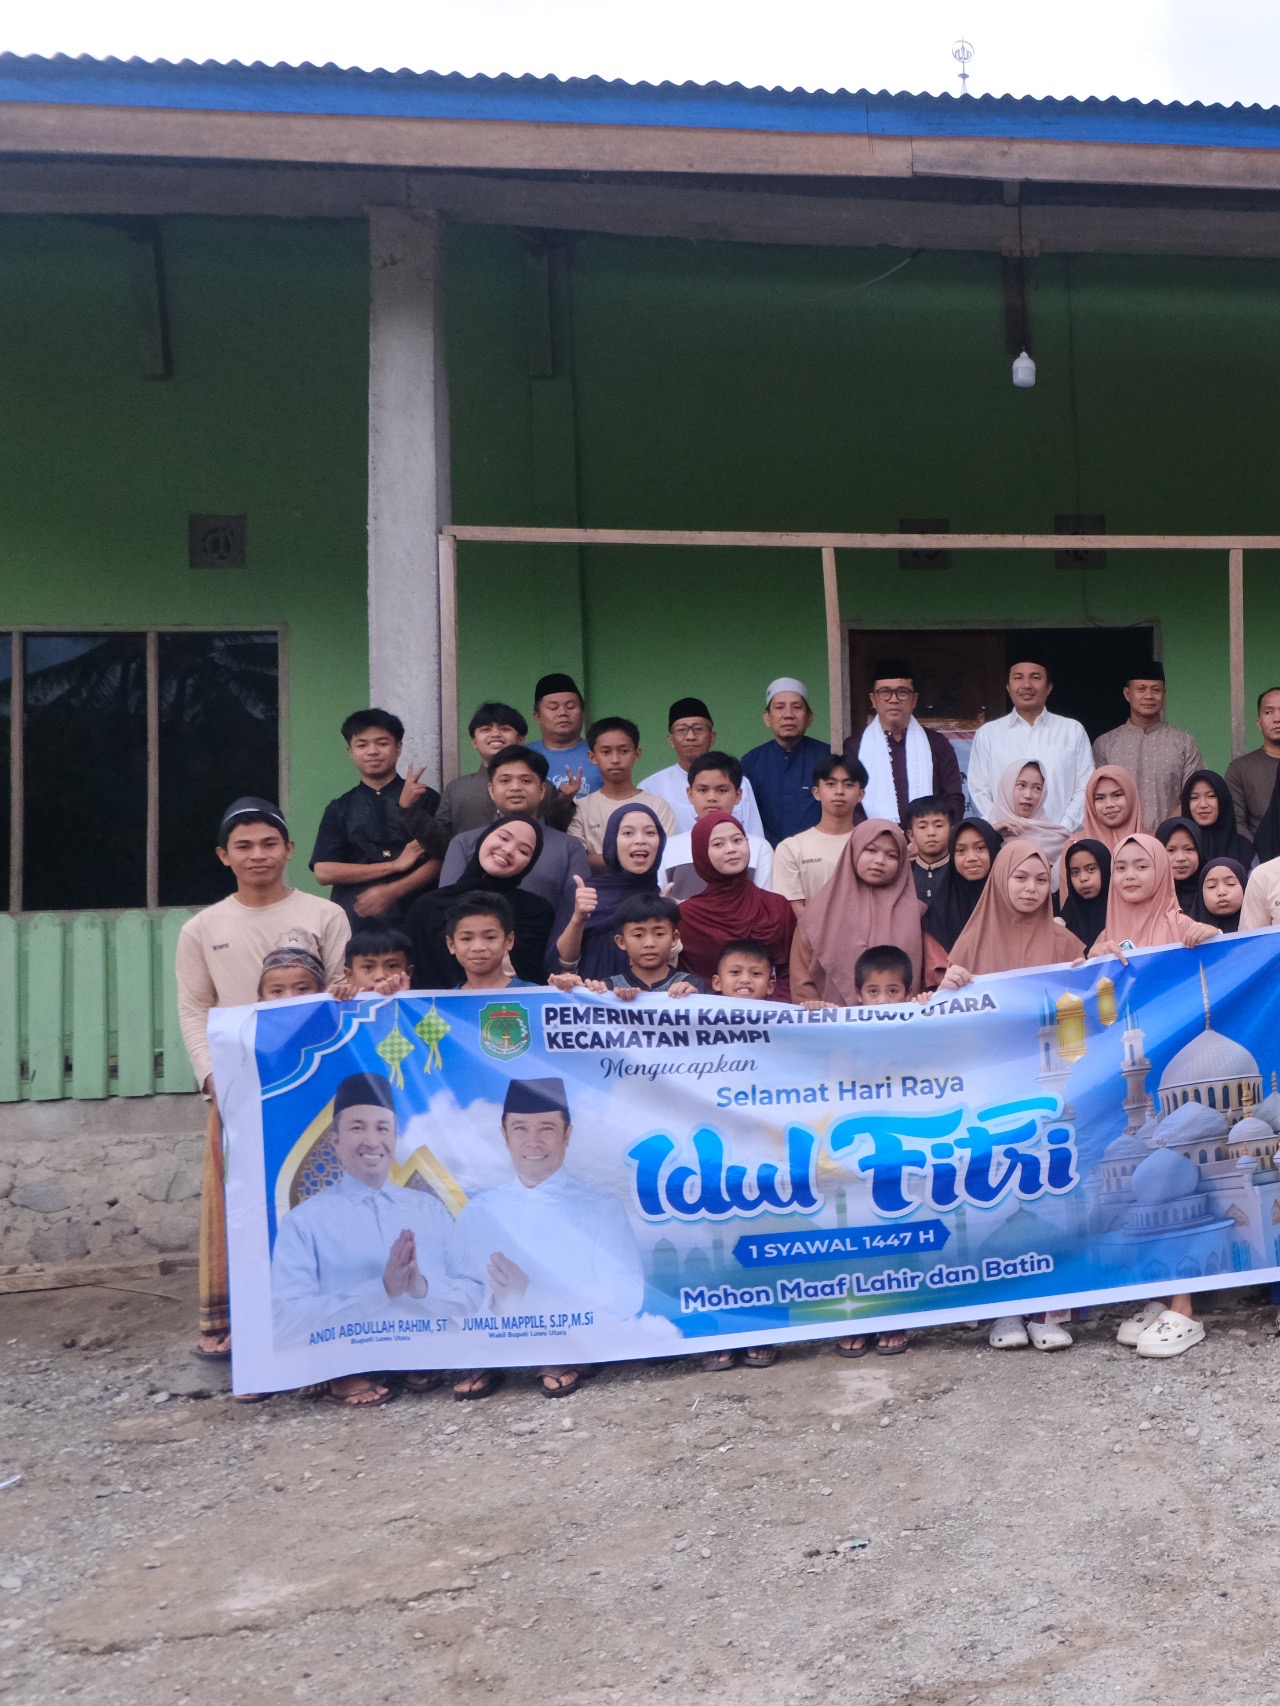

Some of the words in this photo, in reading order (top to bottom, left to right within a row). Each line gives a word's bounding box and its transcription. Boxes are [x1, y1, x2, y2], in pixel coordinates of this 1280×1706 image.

[545, 1006, 691, 1026] PEMERINTAH
[698, 1008, 837, 1026] KABUPATEN
[547, 1030, 690, 1049] KECAMATAN
[696, 1029, 770, 1046] RAMPI
[600, 1053, 758, 1081] Mengucapkan
[716, 1084, 829, 1108] Selamat
[838, 1075, 891, 1101] Hari
[901, 1075, 964, 1099] Raya
[627, 1126, 816, 1216] Idul
[829, 1097, 1077, 1213] Fitri
[749, 1245, 758, 1259] 1
[764, 1237, 858, 1258] SYAWAL
[862, 1232, 913, 1249] 1447
[919, 1229, 935, 1244] H
[684, 1287, 771, 1310] Mohon
[779, 1276, 847, 1300] Maaf
[855, 1271, 921, 1293] Lahir
[929, 1267, 976, 1285] dan
[986, 1254, 1051, 1279] Batin
[309, 1327, 336, 1346] ANDI
[338, 1320, 395, 1339] ABDULLAH
[398, 1319, 434, 1334] RAHIM,
[436, 1318, 448, 1332] ST
[462, 1317, 499, 1331] JUMAIL
[501, 1315, 547, 1330] MAPPILE,
